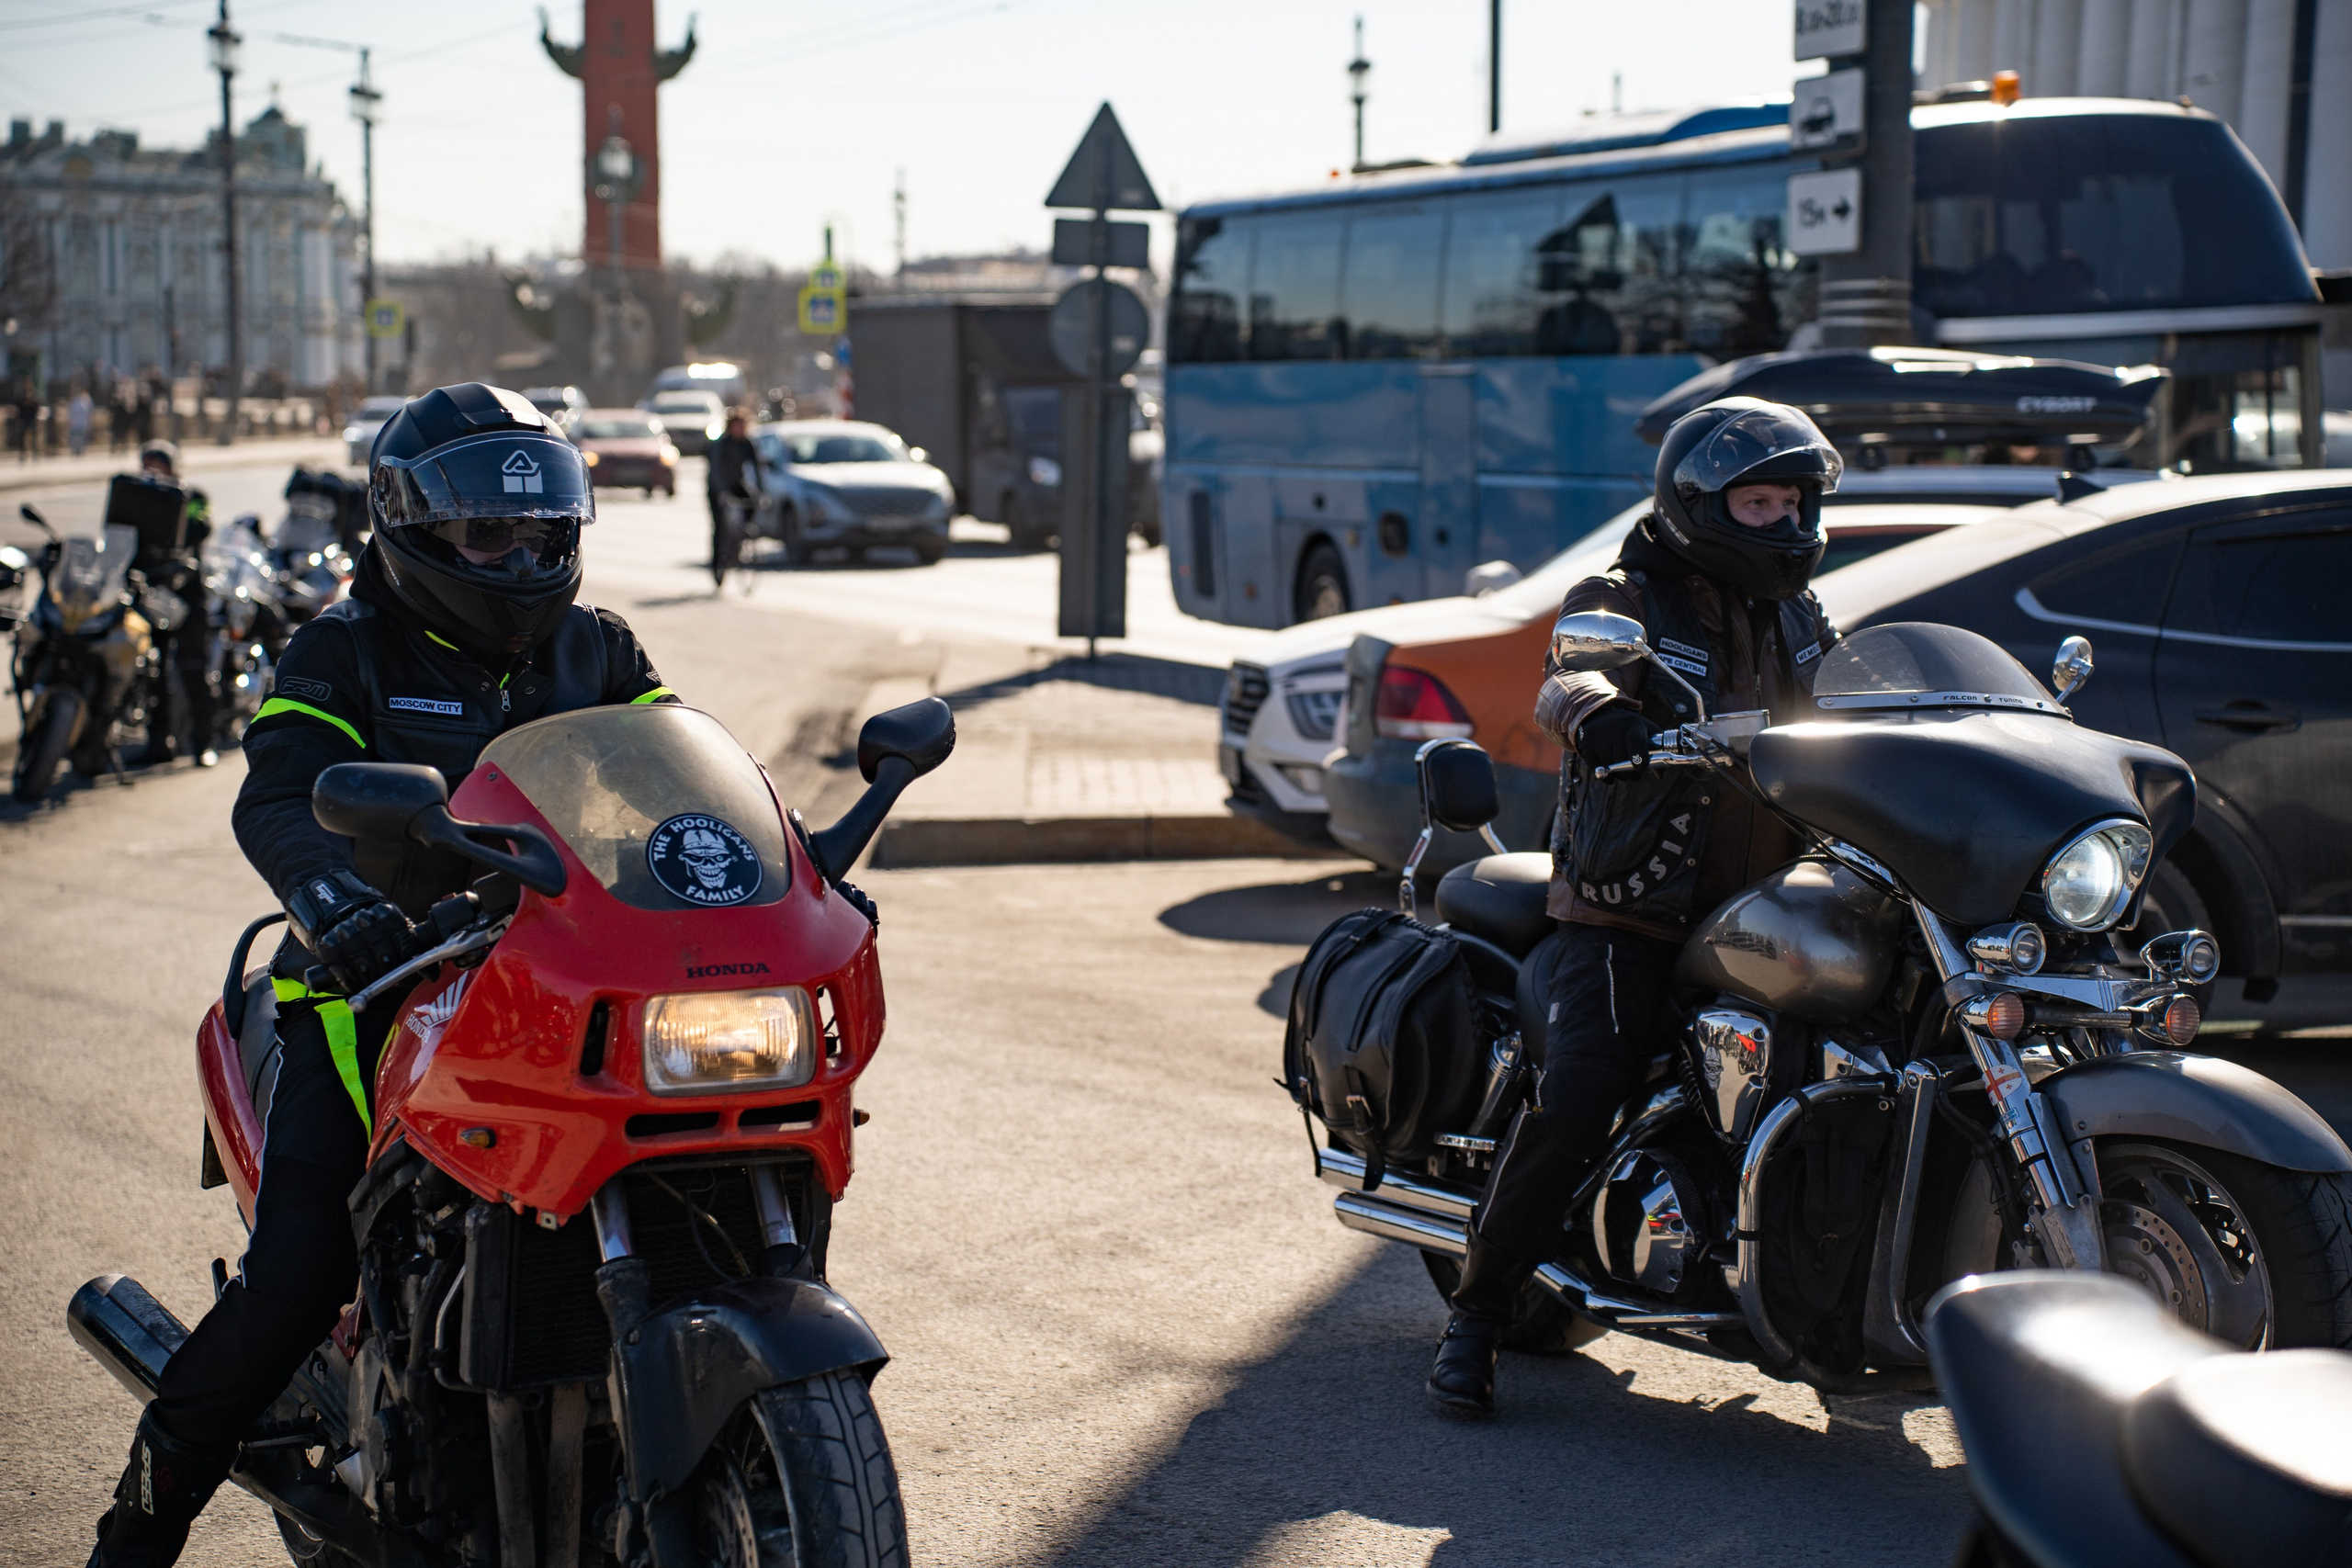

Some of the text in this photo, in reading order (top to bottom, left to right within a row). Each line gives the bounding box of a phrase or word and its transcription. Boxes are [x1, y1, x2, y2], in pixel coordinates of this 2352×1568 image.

[1661, 639, 1707, 660] HOOLIGANS
[1674, 660, 1704, 674] CENTRAL
[390, 699, 460, 713] MOSCOW CITY
[653, 818, 755, 862] THE HOOLIGANS
[1581, 813, 1690, 904] RUSSIA
[685, 885, 745, 903] FAMILY
[686, 963, 771, 979] HONDA
[405, 1013, 432, 1043] HONDA
